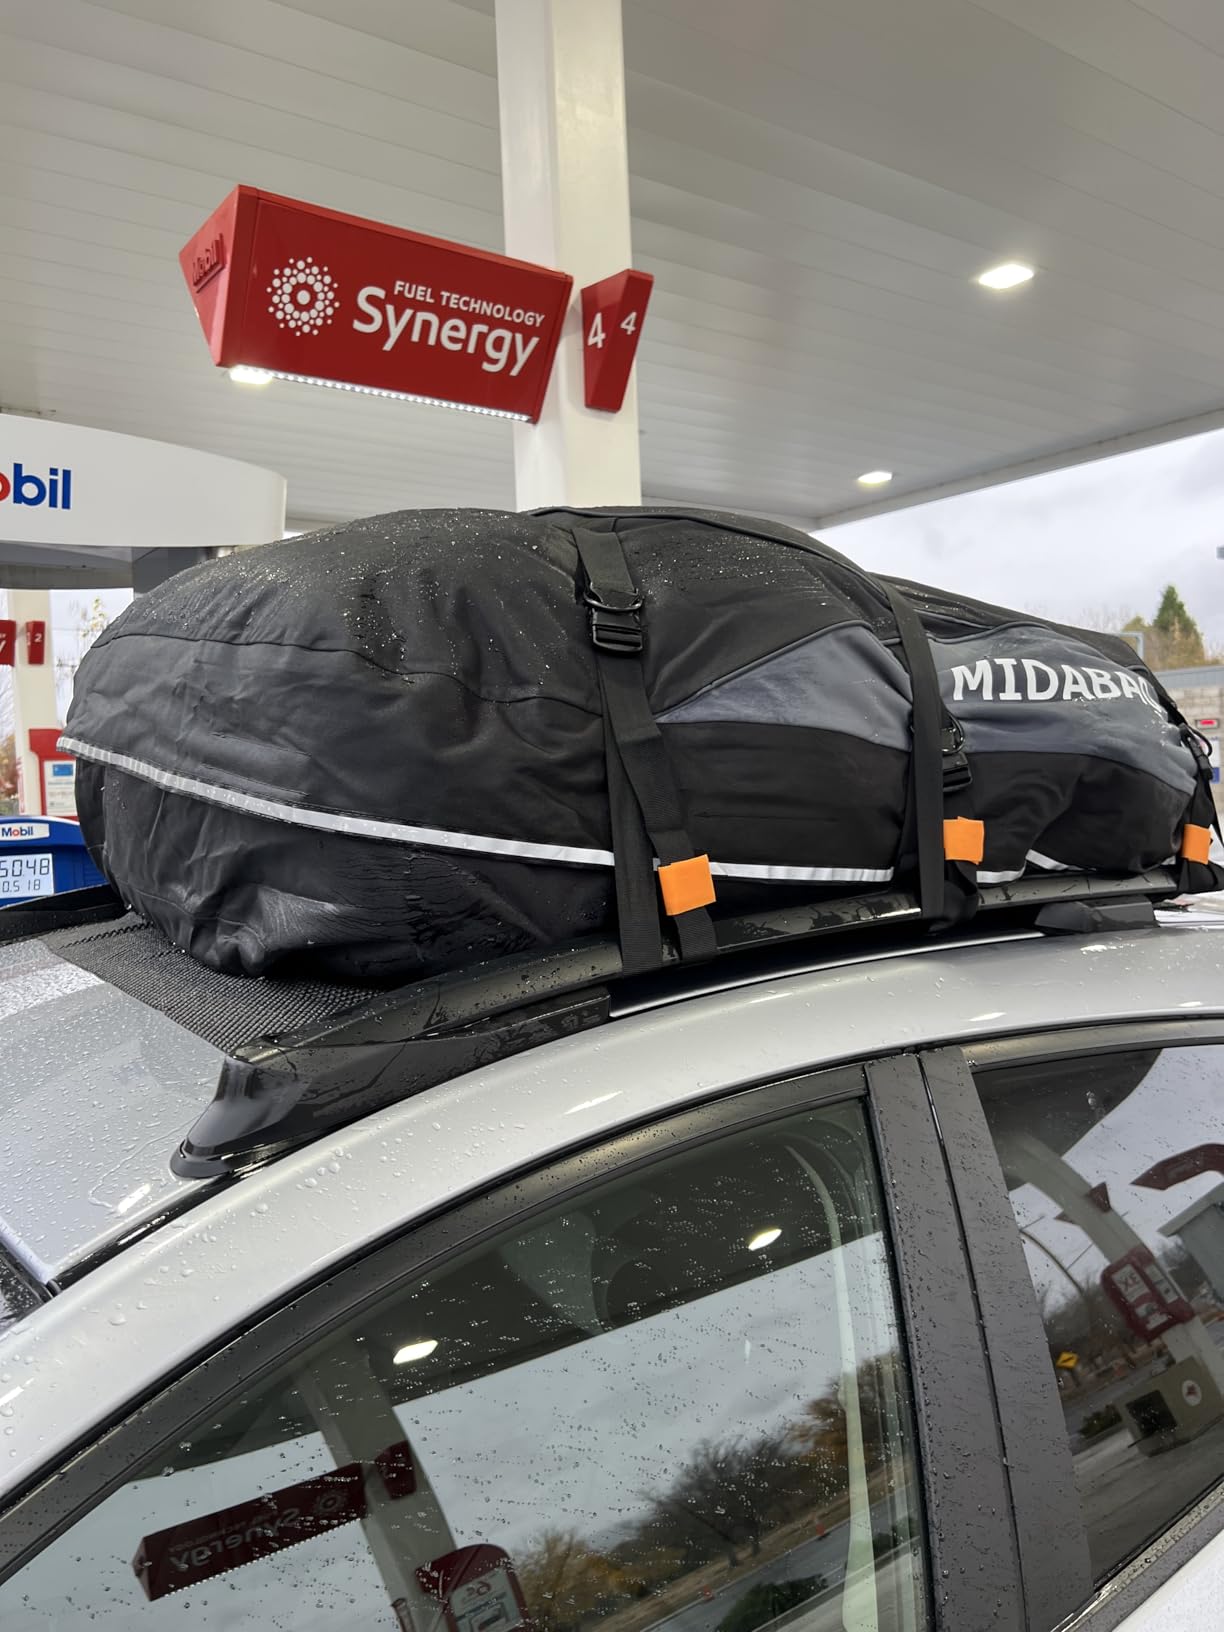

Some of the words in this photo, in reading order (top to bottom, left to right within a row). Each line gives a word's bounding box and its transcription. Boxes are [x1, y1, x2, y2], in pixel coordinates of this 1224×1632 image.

[393, 280, 435, 303] FUEL
[440, 291, 546, 327] TECHNOLOGY
[352, 286, 540, 376] Synergy
[587, 312, 606, 348] 4
[620, 311, 637, 335] 4
[1, 826, 34, 837] Mobil
